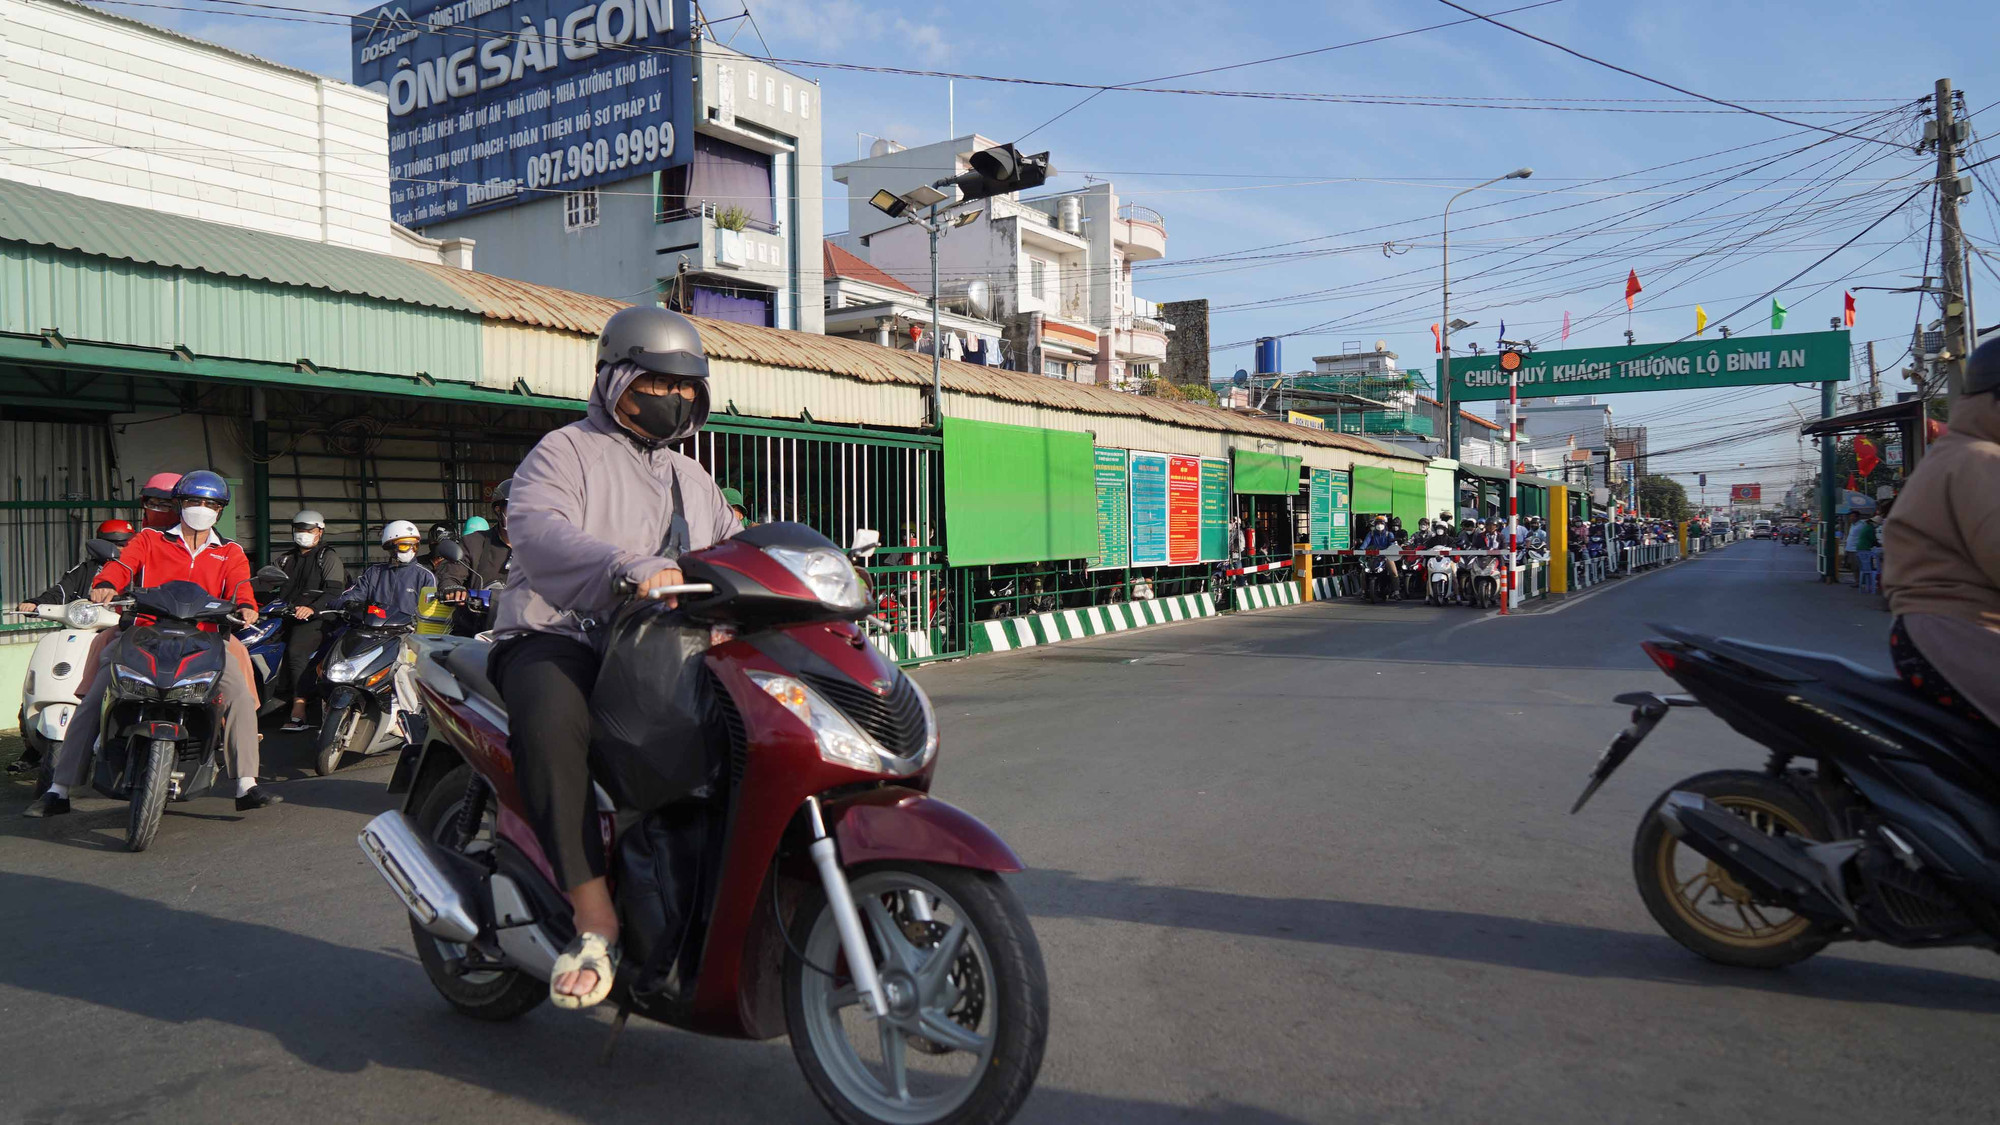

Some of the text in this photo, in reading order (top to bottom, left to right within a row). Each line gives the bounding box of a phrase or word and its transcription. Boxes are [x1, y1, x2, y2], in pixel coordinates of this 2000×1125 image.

[453, 2, 466, 23] TY
[361, 37, 396, 64] DOSA
[362, 57, 477, 116] ÔNG
[488, 102, 501, 124] ÁN
[507, 94, 525, 118] NHÀ
[556, 79, 576, 104] NHÀ
[578, 68, 612, 98] XƯỞNG
[615, 62, 637, 87] KHO
[403, 157, 433, 178] THÔNG
[434, 152, 450, 170] TIN
[451, 146, 469, 166] QUY
[471, 137, 504, 160] HOẠCH
[509, 126, 538, 149] HOÀN
[541, 117, 572, 141] THIỆN
[594, 105, 611, 127] SƠ
[613, 95, 645, 121] PHÁP
[649, 90, 662, 112] LÝ
[527, 121, 675, 189] 097.960.9999
[1552, 359, 1611, 383] KHÁCH
[1617, 355, 1690, 380] THƯỢNG
[1696, 350, 1720, 377] LỘ
[1727, 349, 1771, 372] BÌNH
[1777, 350, 1806, 369] AN
